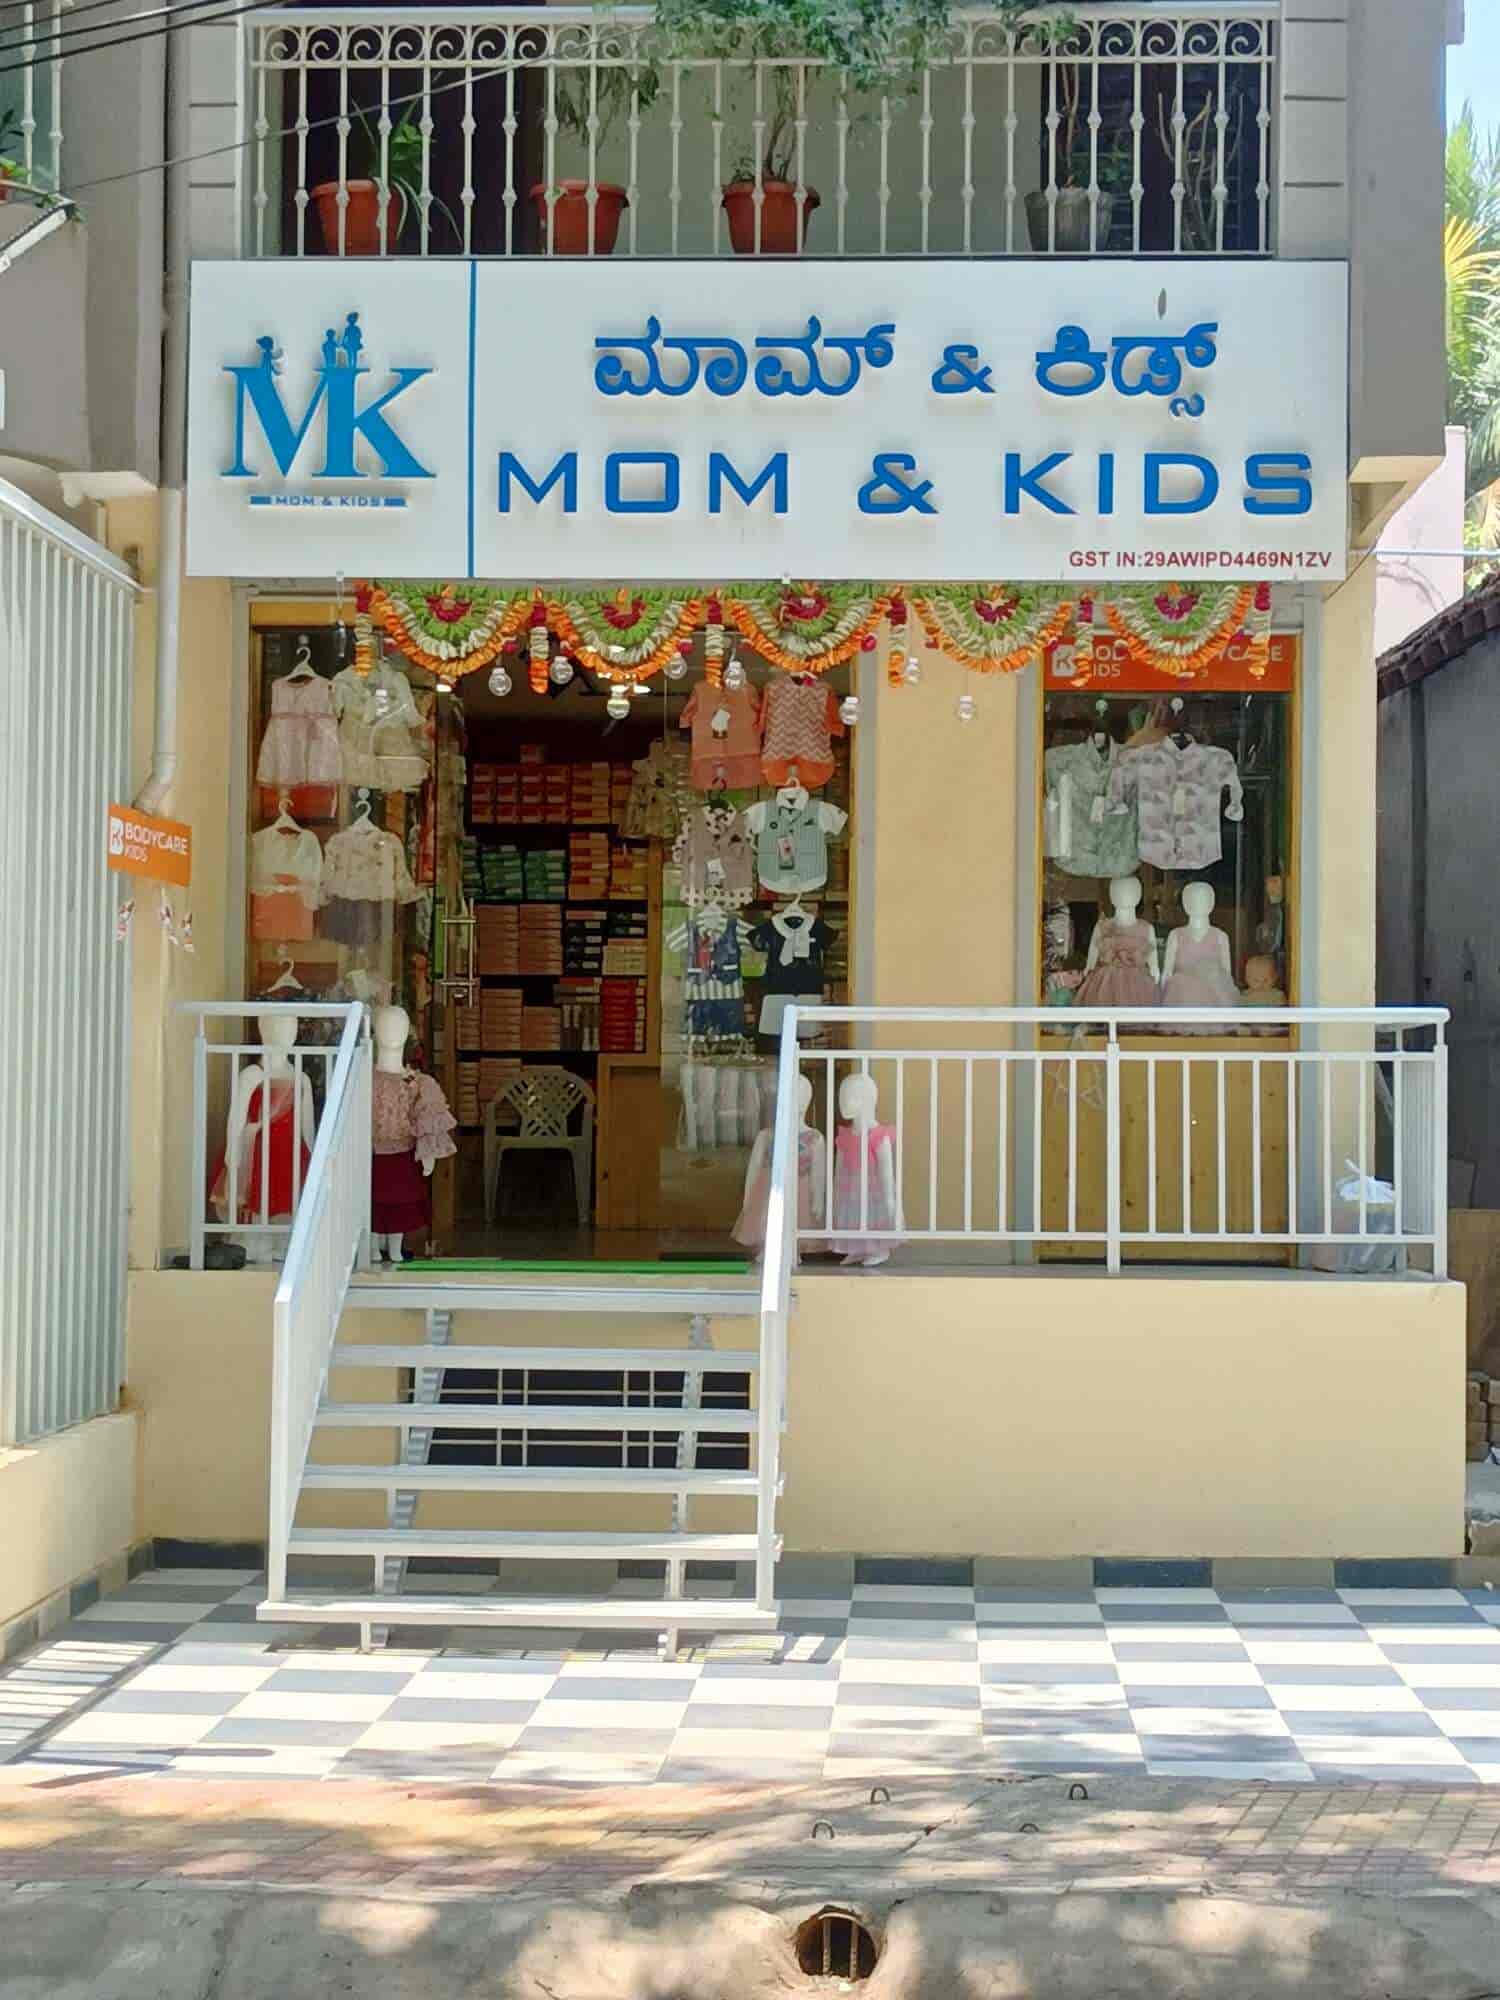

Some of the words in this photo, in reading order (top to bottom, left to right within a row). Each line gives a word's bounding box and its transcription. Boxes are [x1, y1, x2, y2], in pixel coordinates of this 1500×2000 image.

[593, 315, 896, 397] ಮಾಮ್
[931, 343, 996, 395] &
[1035, 322, 1218, 418] ಕಿಡ್ಸ್
[219, 366, 437, 480] MK
[275, 495, 315, 506] MOM
[322, 496, 333, 506] &
[339, 496, 381, 507] KIDS
[498, 451, 789, 513] MOM
[857, 452, 938, 515] &
[1004, 452, 1313, 517] KIDS
[1069, 550, 1110, 568] GST
[1087, 663, 1121, 678] IDS
[124, 821, 188, 856] BODYCARE
